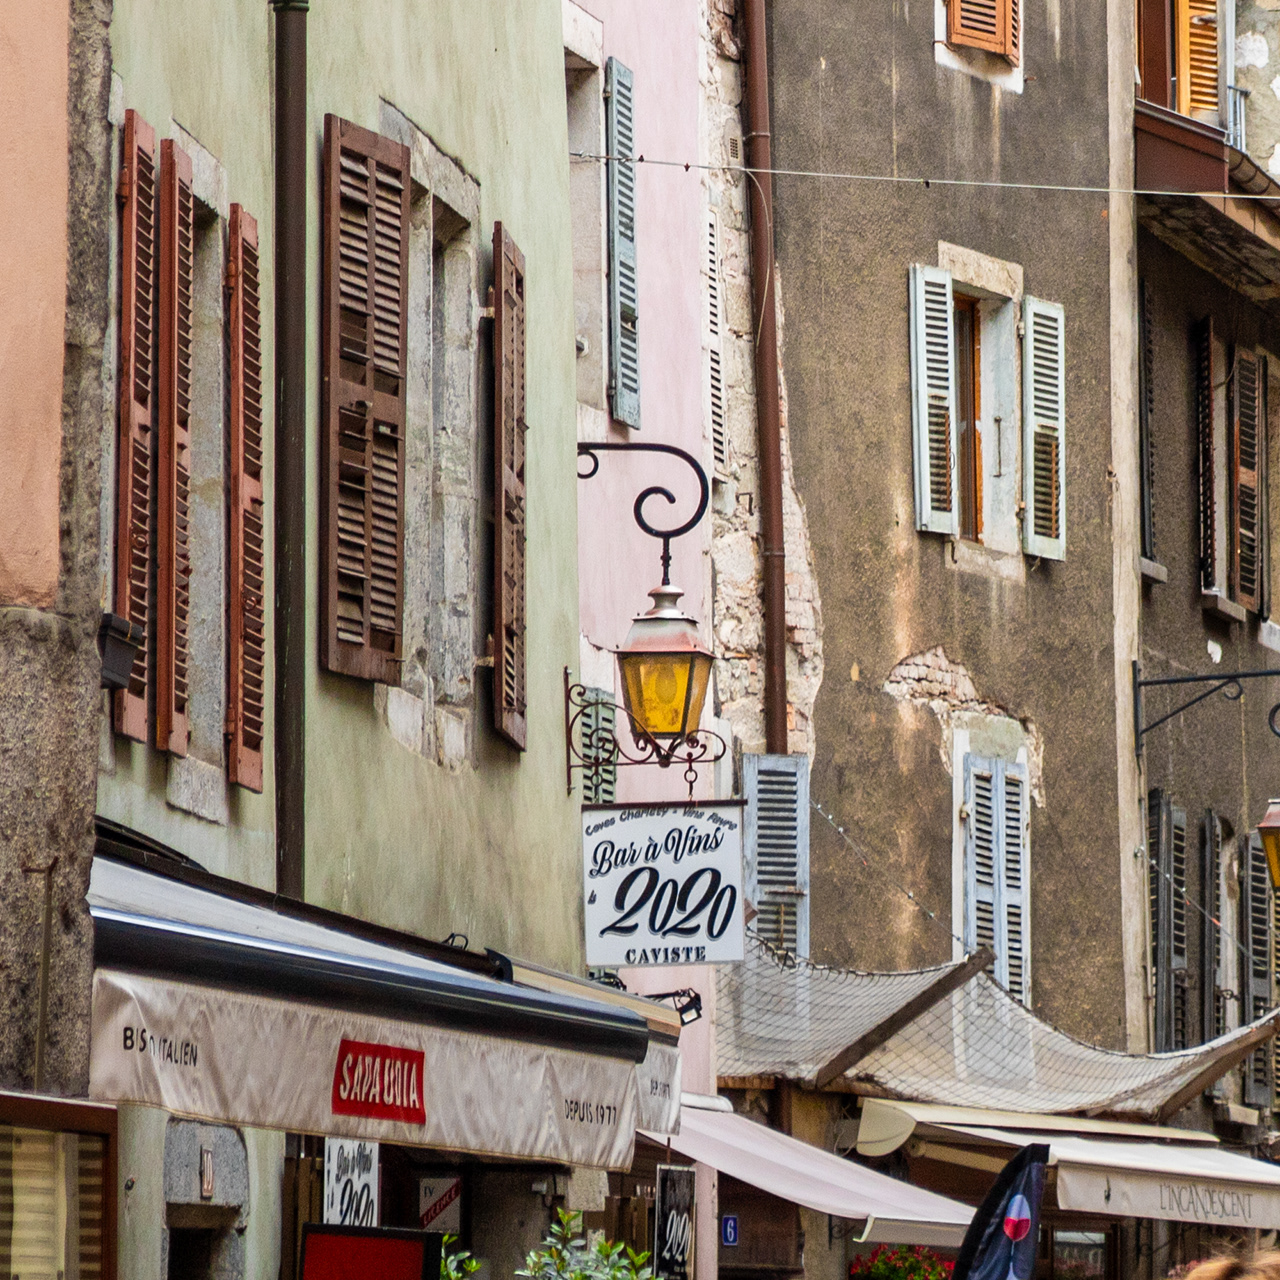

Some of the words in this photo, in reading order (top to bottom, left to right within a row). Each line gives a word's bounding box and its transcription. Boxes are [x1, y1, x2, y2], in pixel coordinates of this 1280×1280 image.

[589, 840, 642, 878] Bar
[643, 836, 664, 863] à
[663, 825, 725, 864] Vins
[599, 866, 737, 941] 2020
[625, 946, 707, 964] CAVISTE
[158, 1037, 198, 1067] ITALIEN
[564, 1098, 593, 1124] DEPUIS
[595, 1103, 618, 1126] 1977
[423, 1185, 435, 1198] IV
[1158, 1182, 1254, 1223] L'INCANDESCENT
[726, 1219, 735, 1242] 6
